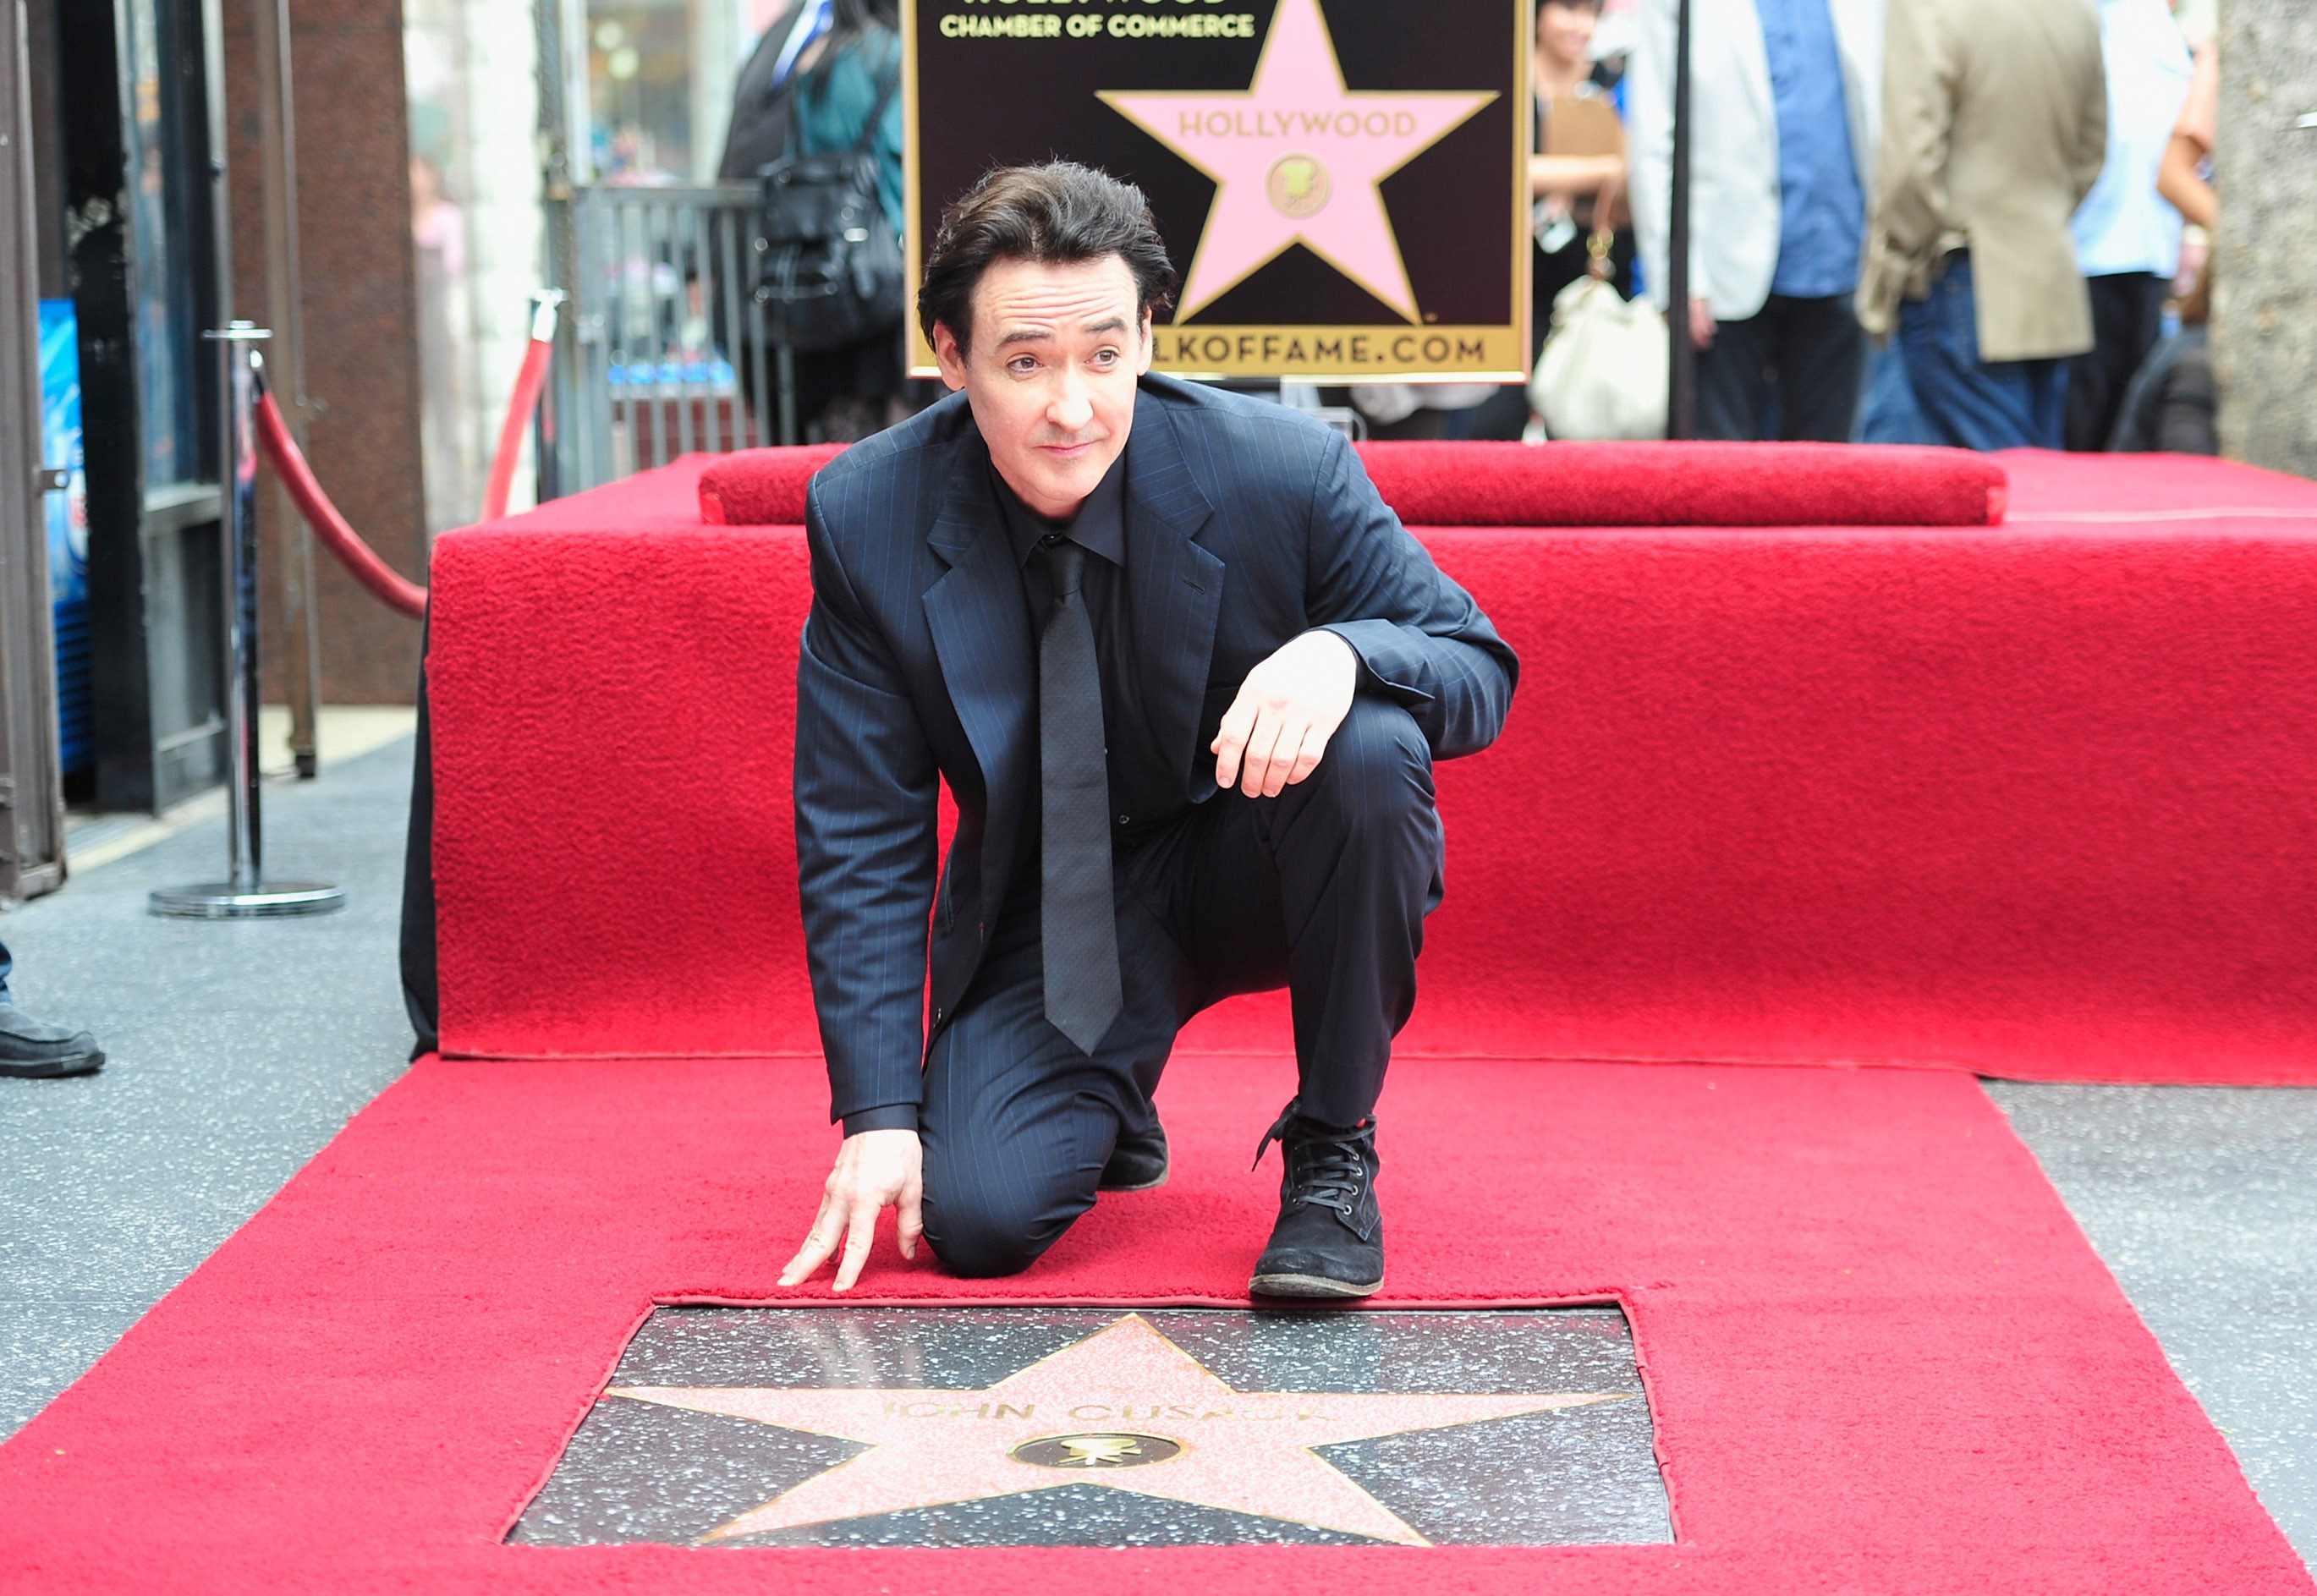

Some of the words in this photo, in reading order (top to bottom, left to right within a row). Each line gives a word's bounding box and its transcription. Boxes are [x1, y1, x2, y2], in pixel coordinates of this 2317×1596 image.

[939, 14, 1062, 37] CHAMBER
[1066, 14, 1103, 37] OF
[1107, 14, 1255, 37] COMMERCE
[1179, 110, 1415, 137] HOLLYWOOD
[1152, 335, 1486, 363] LKOFFAME.COM
[859, 1402, 1035, 1419] JOHN
